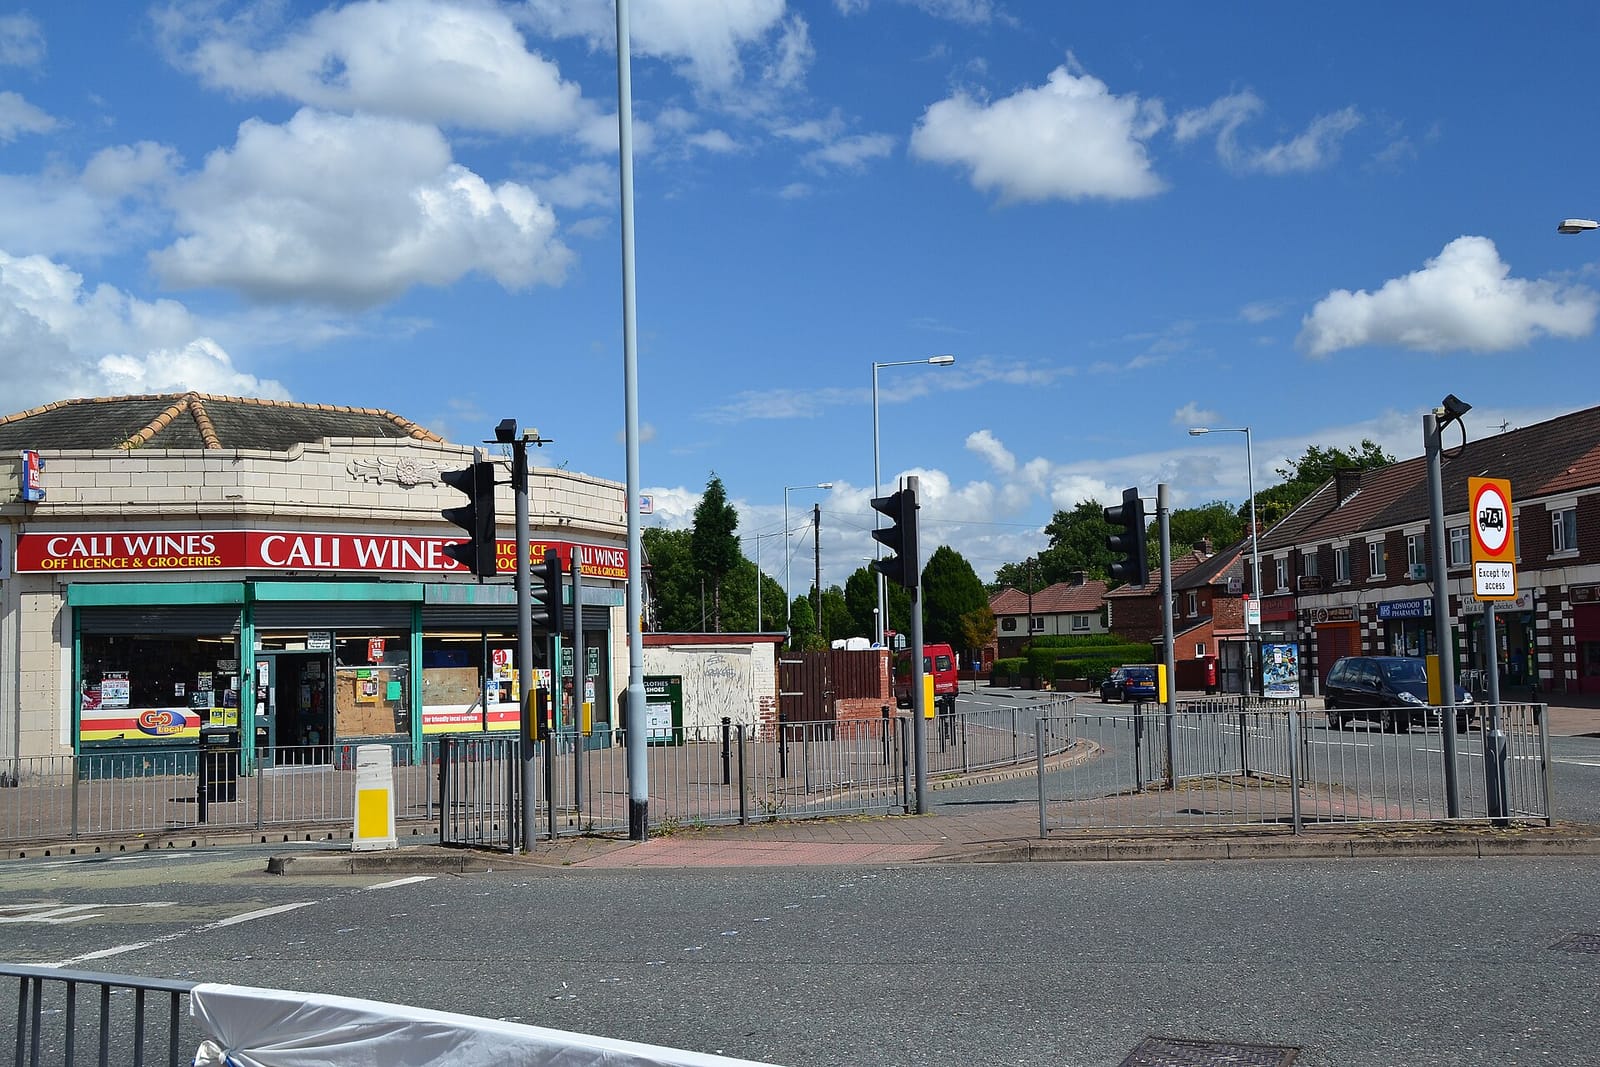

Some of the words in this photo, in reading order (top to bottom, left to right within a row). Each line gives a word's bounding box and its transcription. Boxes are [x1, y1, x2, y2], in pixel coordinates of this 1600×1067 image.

[47, 536, 112, 558] CALI
[123, 534, 216, 556] WINES
[260, 535, 340, 567] CALI
[353, 538, 459, 570] WINES
[594, 548, 625, 568] WINES
[41, 558, 68, 569] OFF
[73, 557, 129, 569] LICENCE
[133, 557, 143, 568] &
[147, 555, 222, 568] GROCERIES
[1478, 568, 1500, 579] Except
[1501, 568, 1510, 578] for
[1485, 582, 1506, 590] access
[1392, 601, 1421, 610] ADSWOOD
[1391, 609, 1421, 617] PHARMACY
[157, 724, 184, 733] Local
